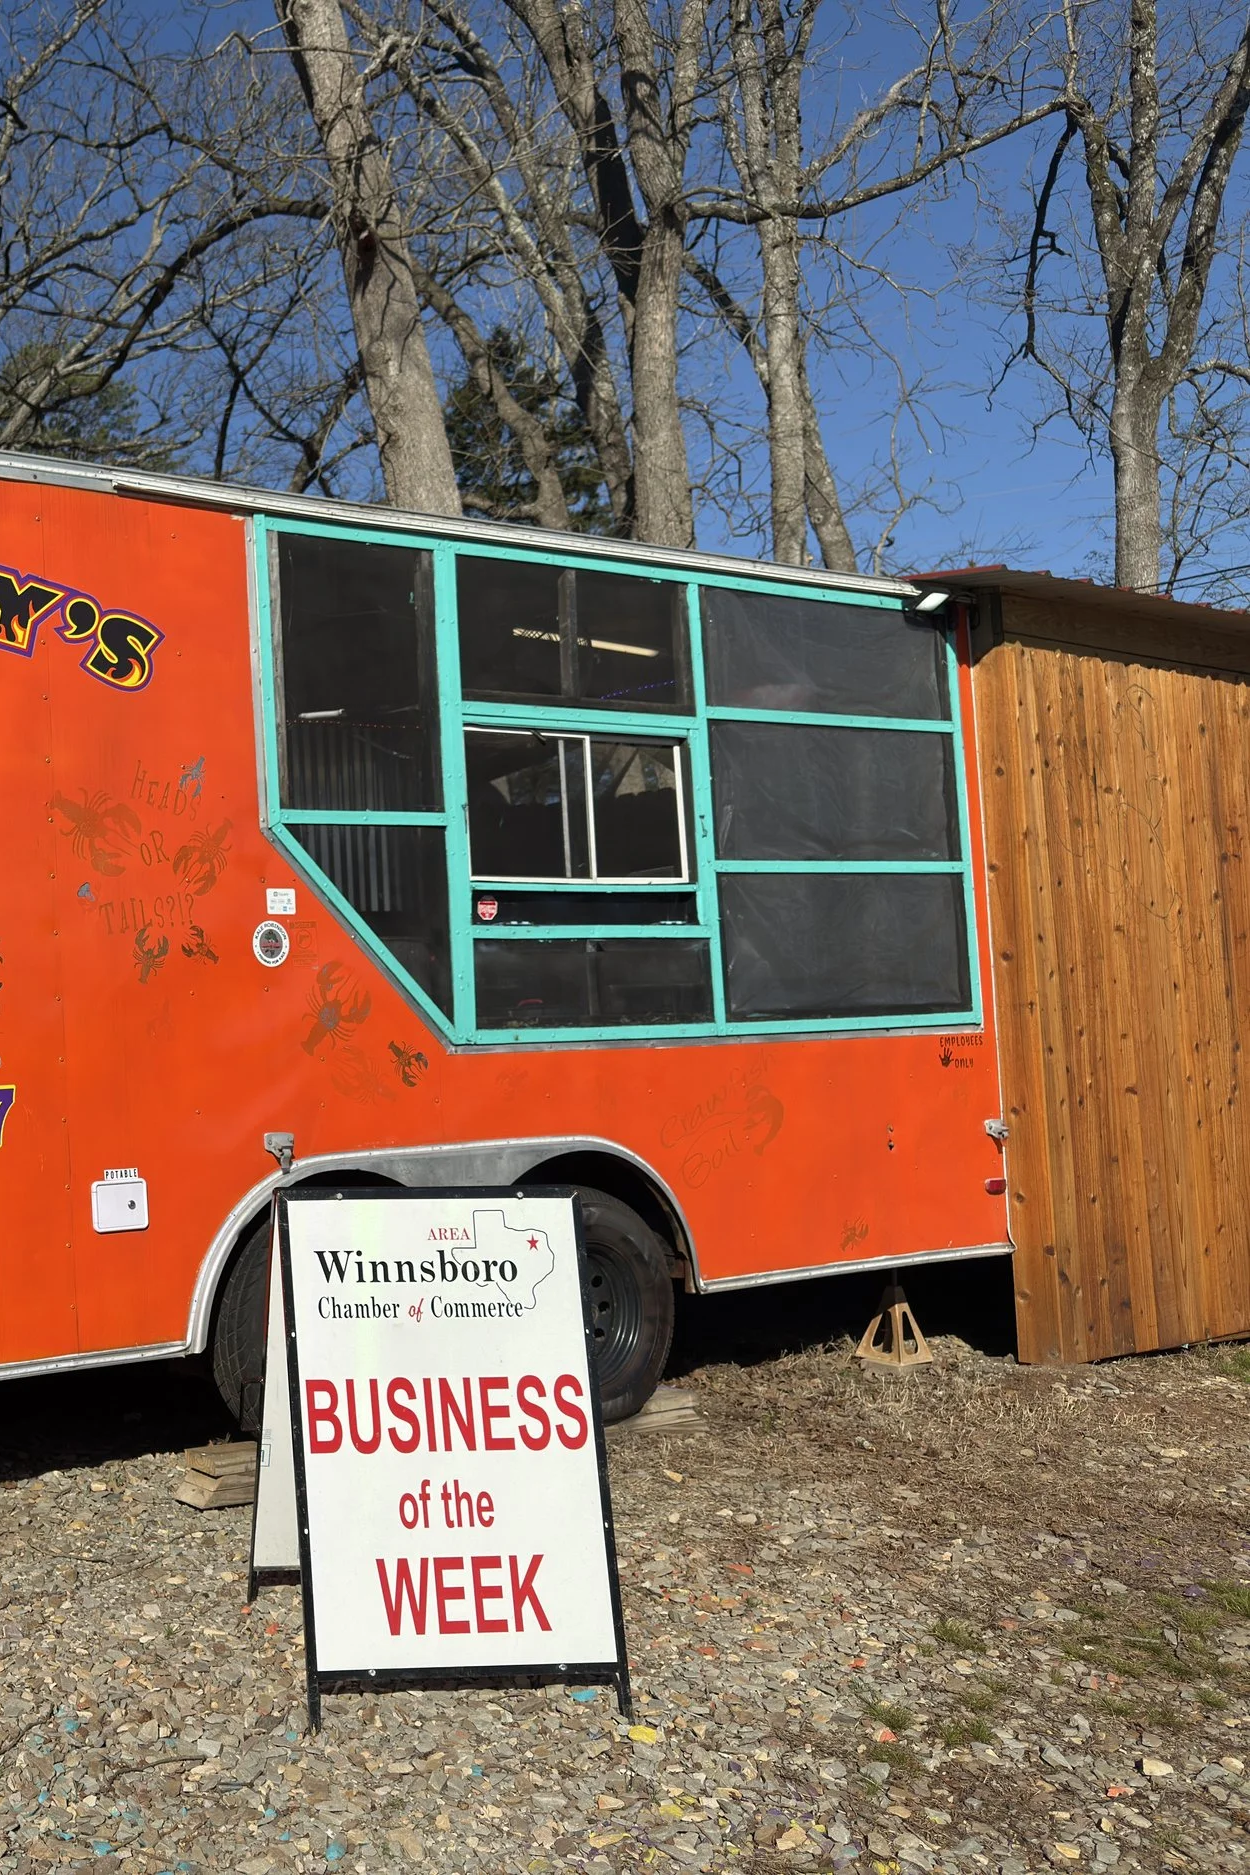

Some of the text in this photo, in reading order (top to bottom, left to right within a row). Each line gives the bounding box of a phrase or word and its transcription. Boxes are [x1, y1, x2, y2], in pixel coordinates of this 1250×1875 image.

[130, 760, 202, 821] HEADS
[140, 830, 170, 867] OR
[940, 1035, 983, 1047] EMPLOYEES
[106, 1169, 137, 1179] POTABLE
[427, 1227, 471, 1241] AREA
[313, 1250, 518, 1284] Winnsboro
[318, 1296, 524, 1322] Chamber of Commerce
[305, 1374, 589, 1455] BUSINESS
[399, 1479, 495, 1530] of the
[376, 1554, 553, 1637] WEEK
